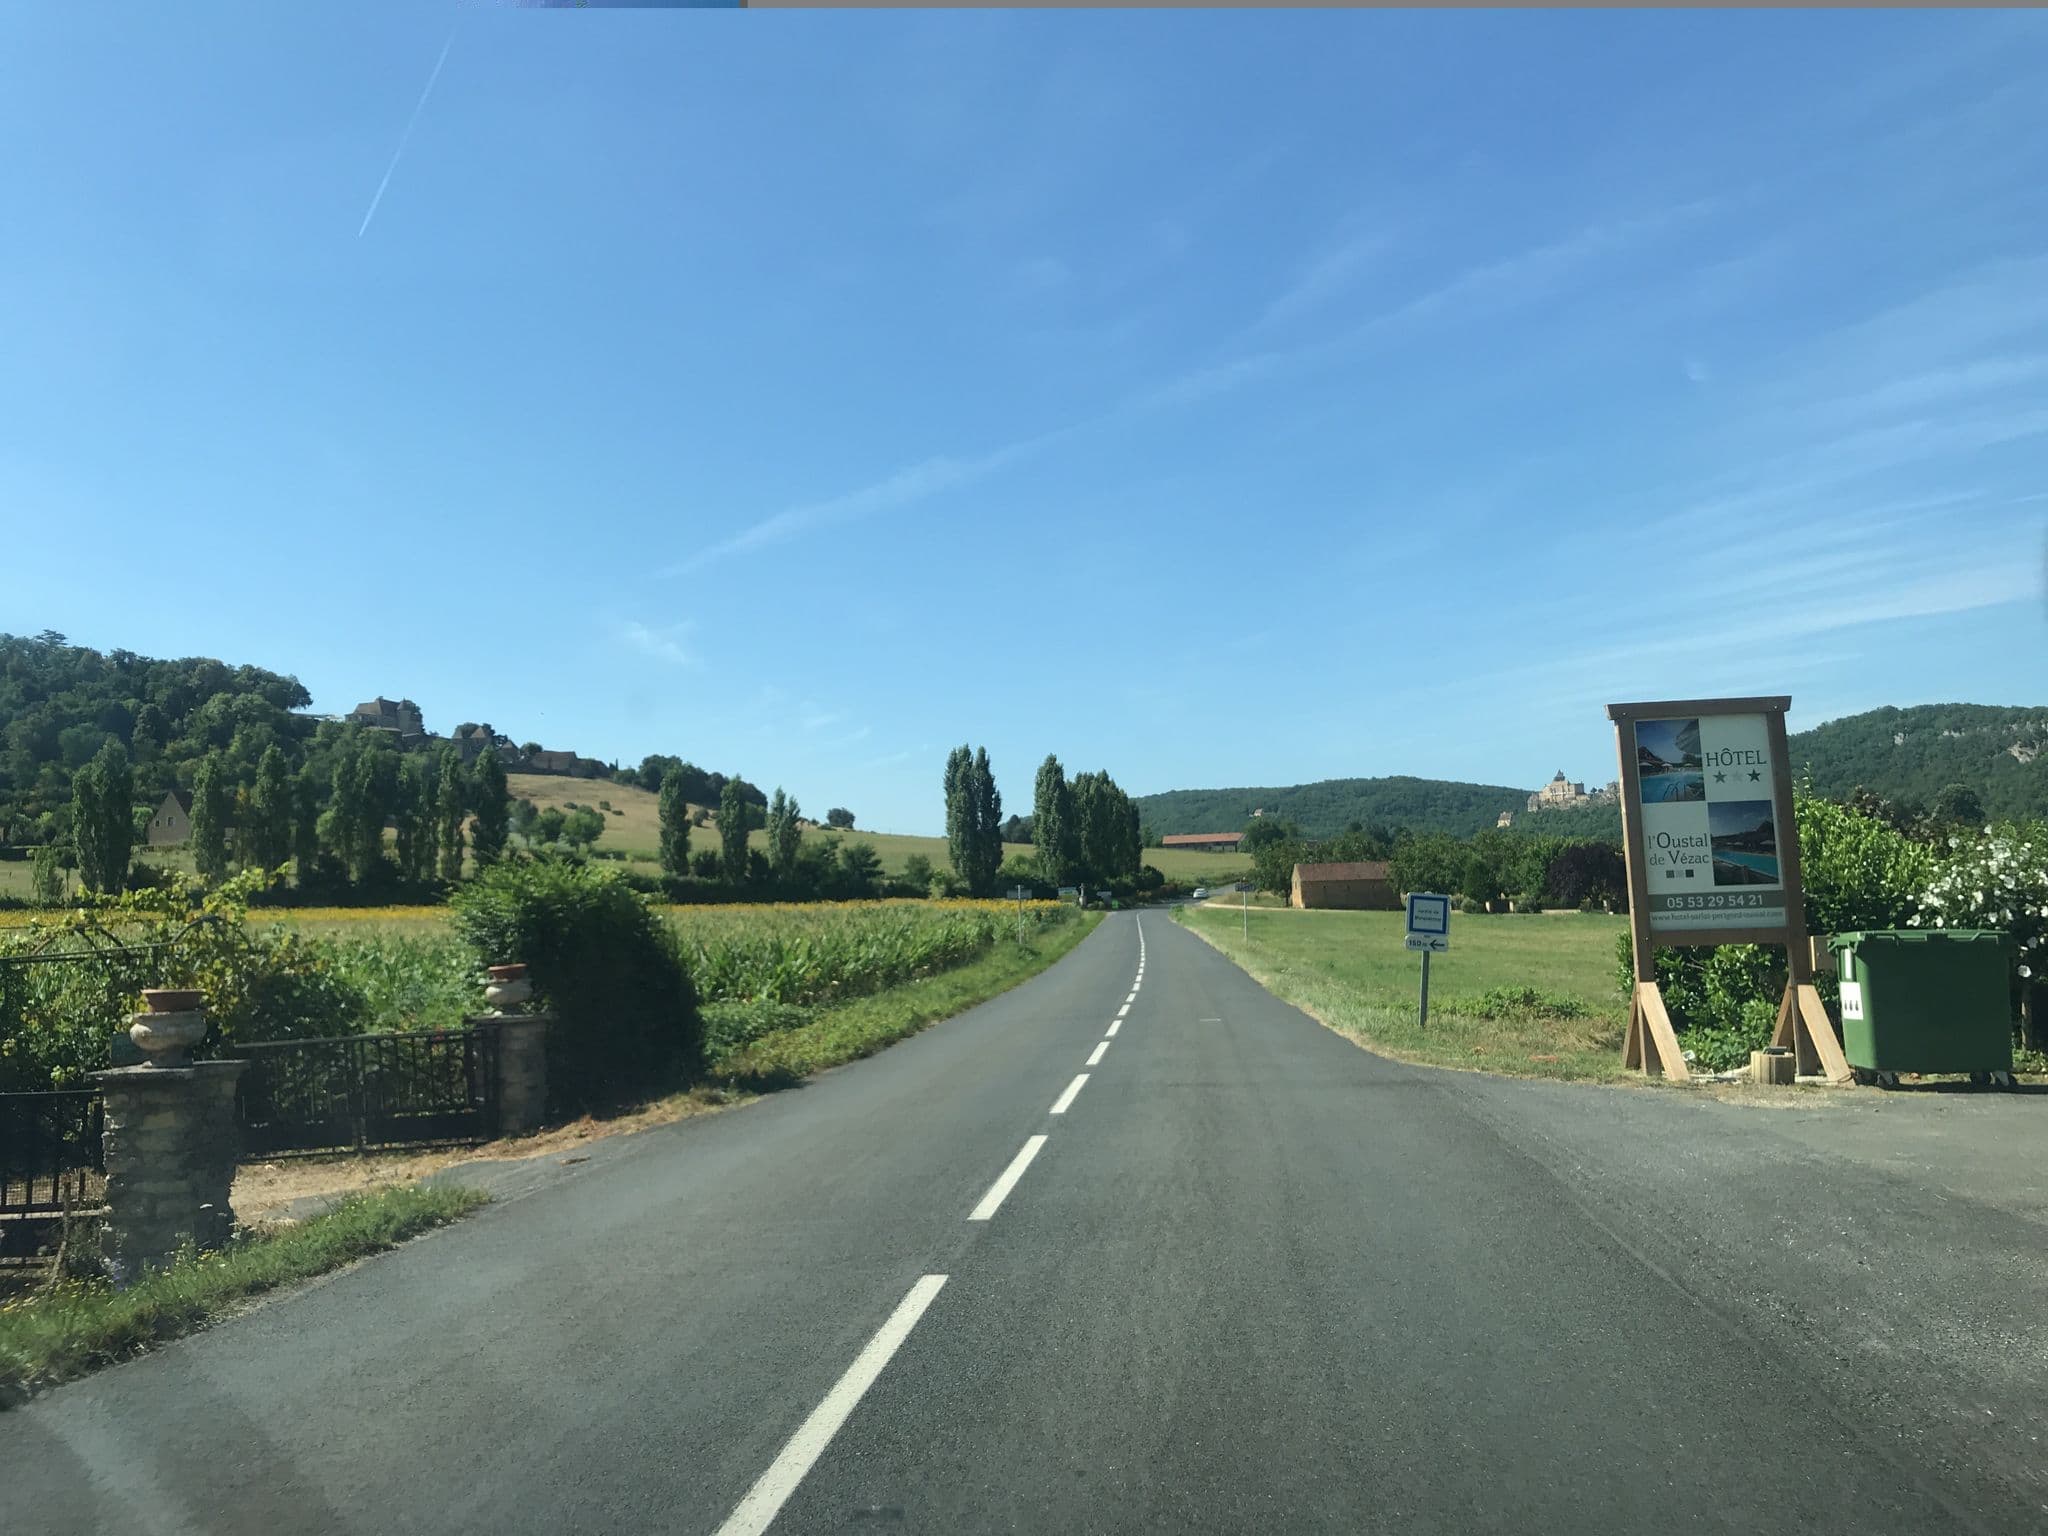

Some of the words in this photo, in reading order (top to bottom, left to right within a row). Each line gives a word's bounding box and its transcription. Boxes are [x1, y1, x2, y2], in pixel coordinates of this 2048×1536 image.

[1706, 747, 1767, 767] HÔTEL
[1648, 832, 1708, 849] l'Oustal
[1649, 853, 1665, 866] de
[1668, 850, 1710, 865] Vézac
[1667, 897, 1684, 909] 05
[1687, 896, 1704, 908] 53
[1707, 895, 1724, 907] 29
[1728, 895, 1745, 907] 54
[1748, 894, 1763, 906] 21
